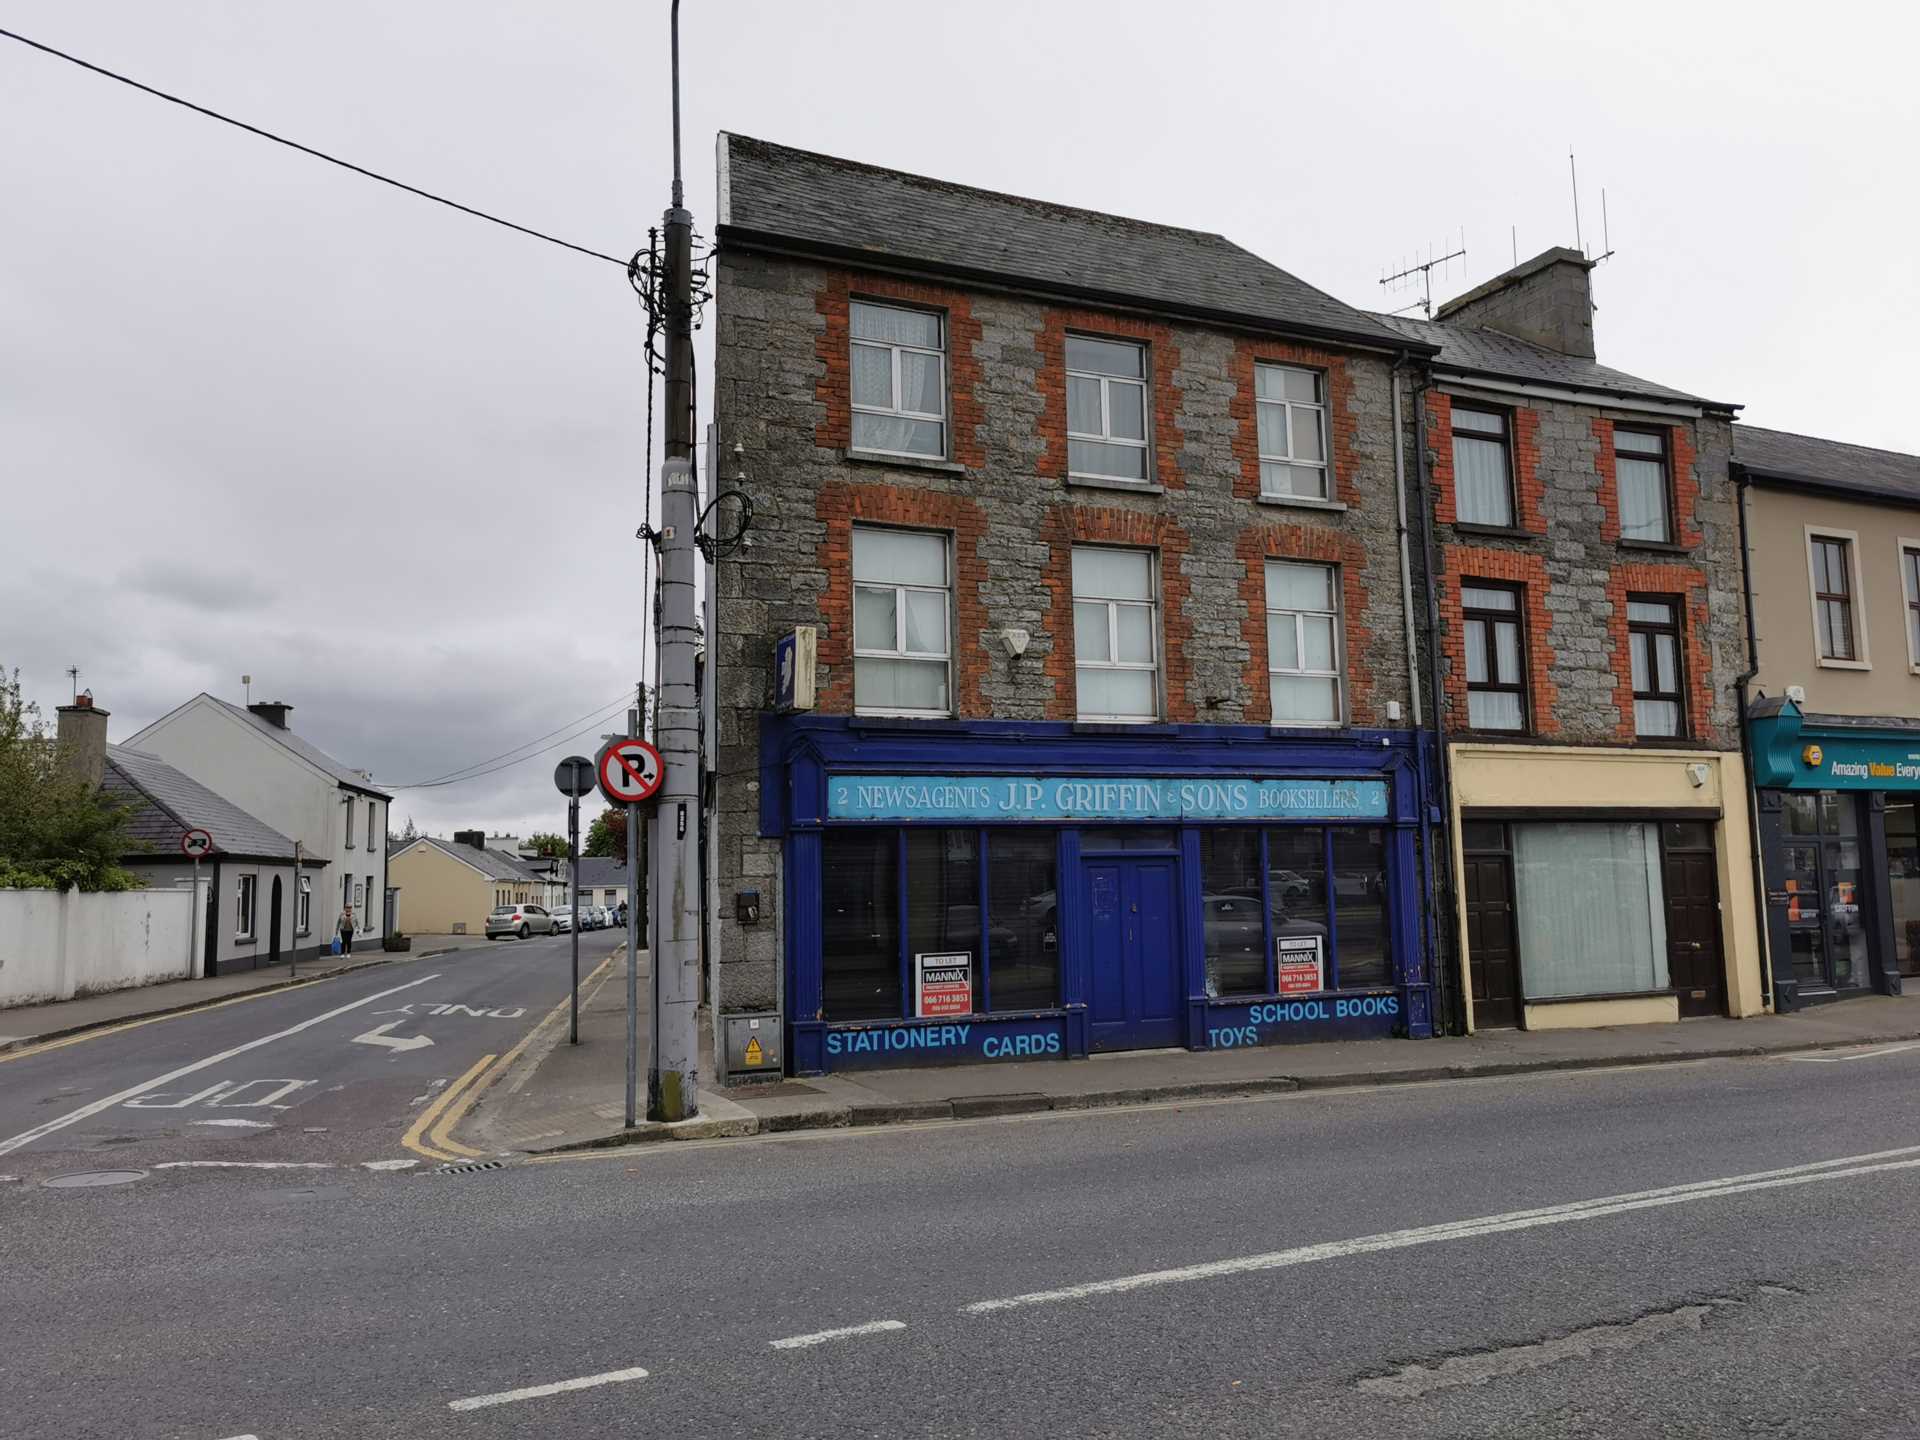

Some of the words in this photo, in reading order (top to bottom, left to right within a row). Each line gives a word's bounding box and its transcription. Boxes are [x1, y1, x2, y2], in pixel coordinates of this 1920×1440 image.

[621, 753, 645, 787] P
[1831, 761, 1868, 779] Amazing
[1869, 762, 1895, 776] Value
[1896, 763, 1920, 780] Every
[837, 787, 848, 805] 2
[856, 785, 991, 809] NEWSAGENTS
[999, 783, 1046, 811] J.P.
[1055, 783, 1161, 811] GRIFFIN
[1180, 784, 1249, 811] SONS
[1258, 788, 1360, 809] BOOKSELLERS
[1282, 952, 1313, 963] MANNIX
[926, 969, 965, 982] MANNIX
[1250, 1000, 1330, 1024] SCHOOL
[1336, 996, 1400, 1018] BOOKS
[826, 1024, 971, 1054] STATIONERY
[983, 1032, 1060, 1057] CARDS
[1208, 1026, 1258, 1048] TOYS
